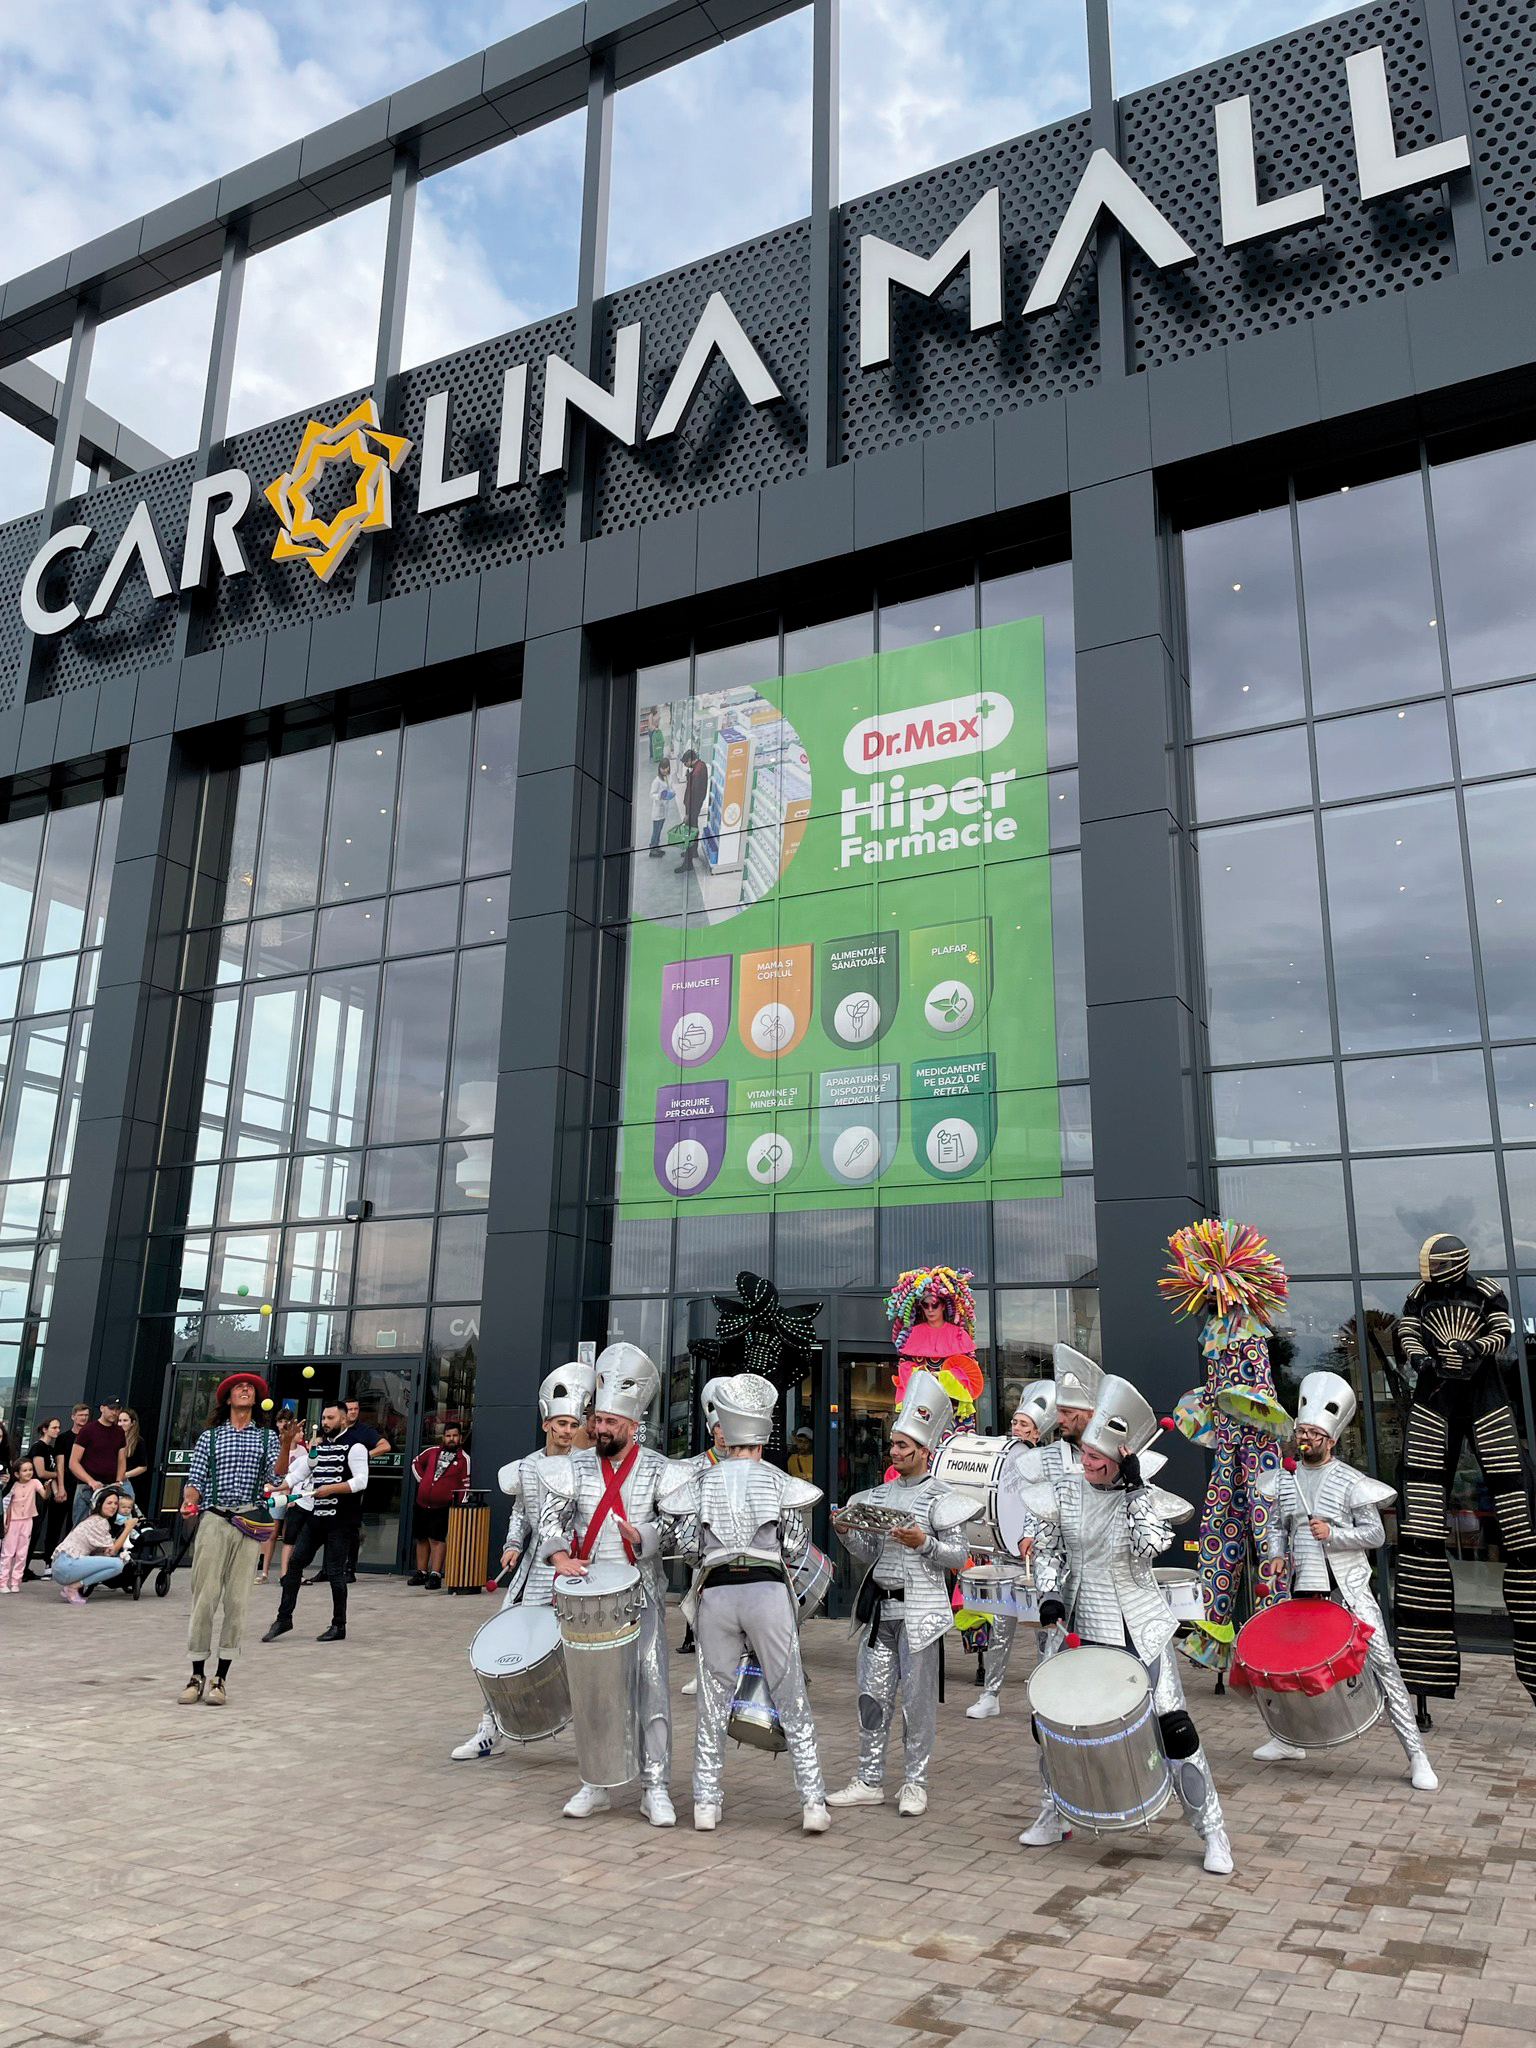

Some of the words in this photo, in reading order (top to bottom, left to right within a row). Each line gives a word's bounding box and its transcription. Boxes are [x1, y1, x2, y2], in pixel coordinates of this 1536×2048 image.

[860, 45, 1471, 369] MALL
[863, 715, 979, 761] Dr.Max
[841, 768, 1017, 837] Hiper
[841, 811, 1018, 868] Farmacie
[931, 943, 968, 956] PLAFAR
[757, 961, 784, 971] MAMA
[757, 970, 793, 980] COPILUL
[916, 1062, 987, 1078] MEDICAMENTE
[826, 1072, 880, 1087] APARATURĂ
[924, 1077, 936, 1087] PE
[938, 1074, 964, 1087] BAZĂ
[966, 1073, 980, 1084] DE
[747, 1088, 788, 1099] VITAMINE
[830, 1084, 887, 1097] DISPOZITIVE
[671, 1097, 710, 1109] ÎNGRIJIRE
[750, 1098, 794, 1109] MINERALE
[834, 1094, 881, 1106] MEDICALE
[665, 1106, 715, 1118] PERSONALĂ
[946, 1459, 990, 1474] THOMANN
